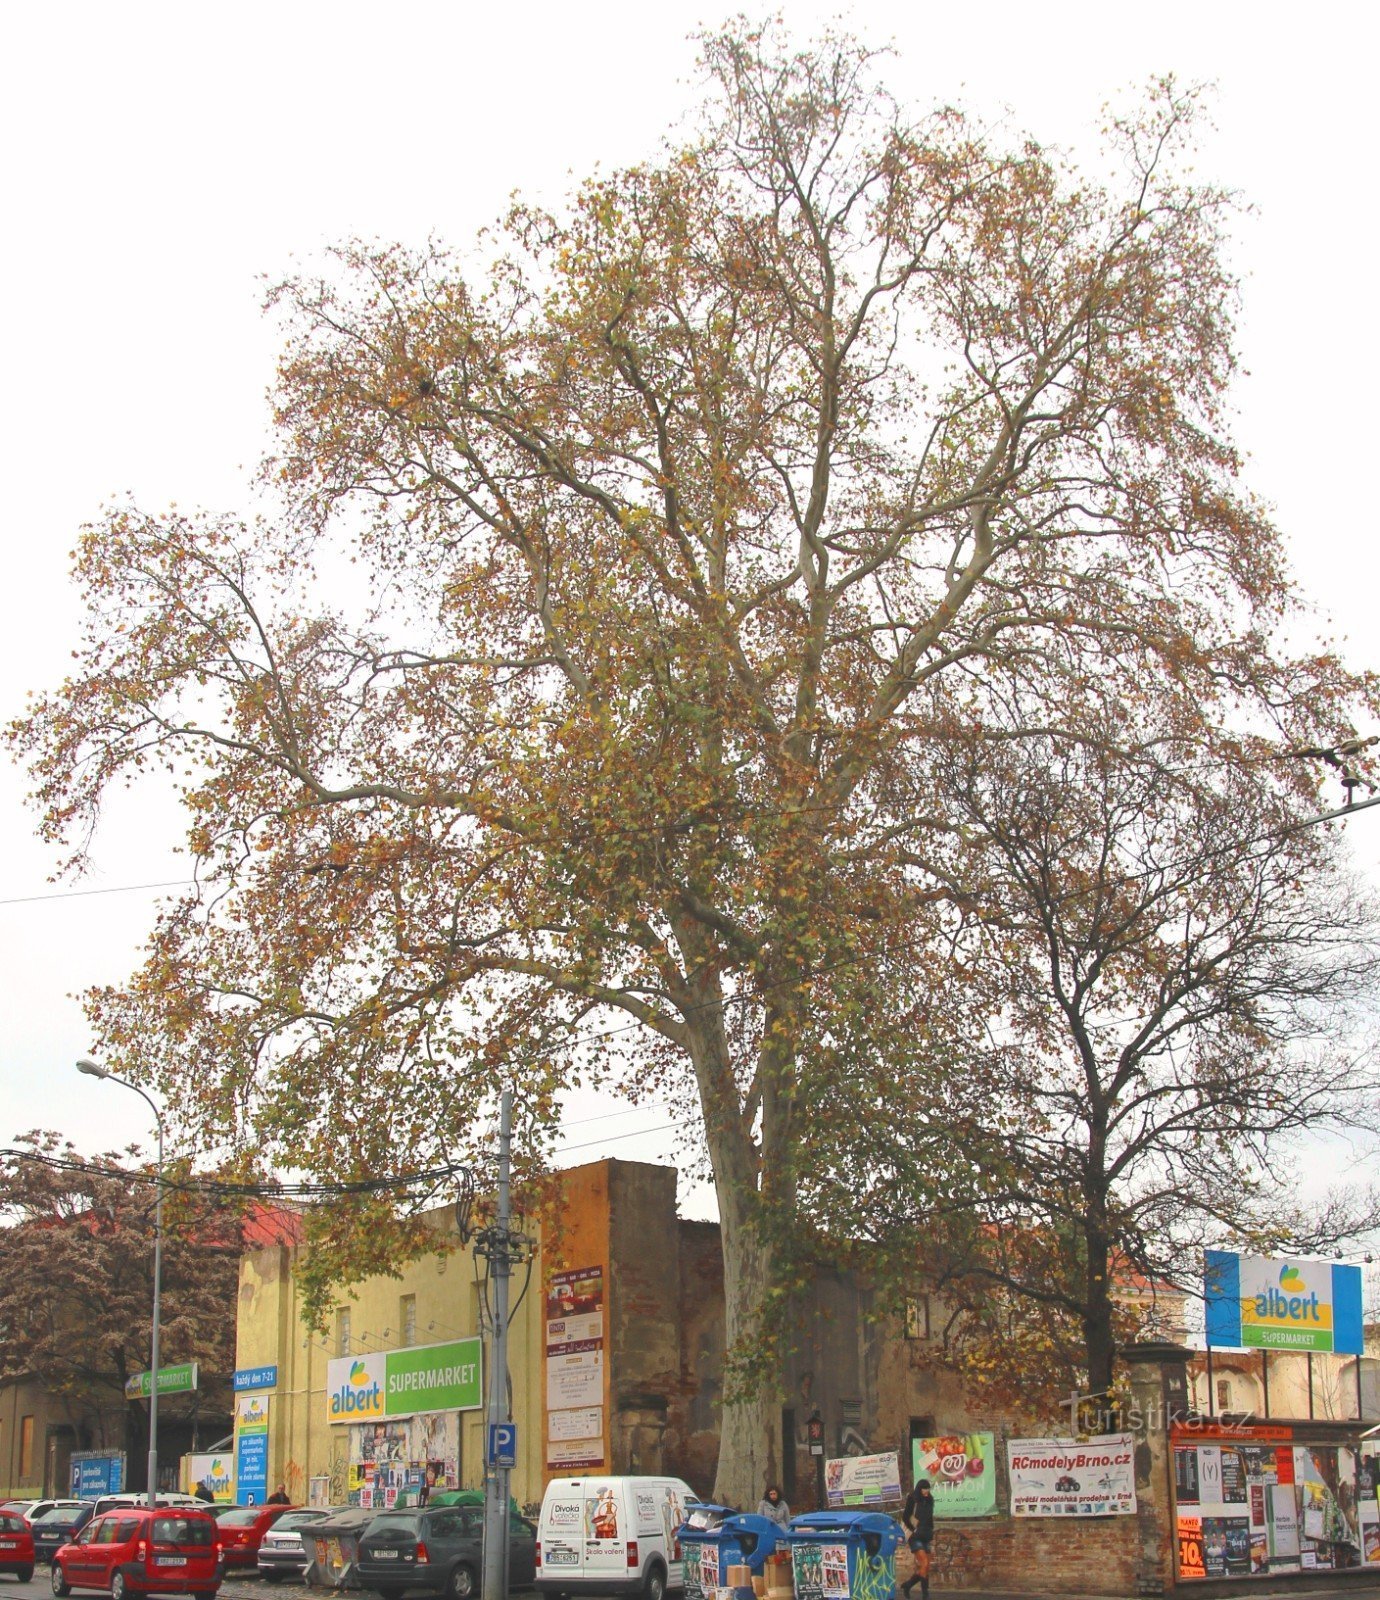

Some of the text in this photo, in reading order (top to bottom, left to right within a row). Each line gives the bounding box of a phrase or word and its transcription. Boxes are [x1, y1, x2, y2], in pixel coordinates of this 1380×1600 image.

[1256, 1287, 1319, 1321] albert
[1262, 1331, 1315, 1345] SUPERMARKET
[144, 1371, 189, 1390] SUERMARKET
[252, 1373, 261, 1383] den
[332, 1363, 475, 1414] albert SUPERMARKET
[244, 1409, 263, 1423] albert
[494, 1429, 511, 1454] P
[1012, 1454, 1131, 1471] RCmodelyBrno.cz
[74, 1468, 80, 1484] P
[554, 1504, 580, 1513] Divoká
